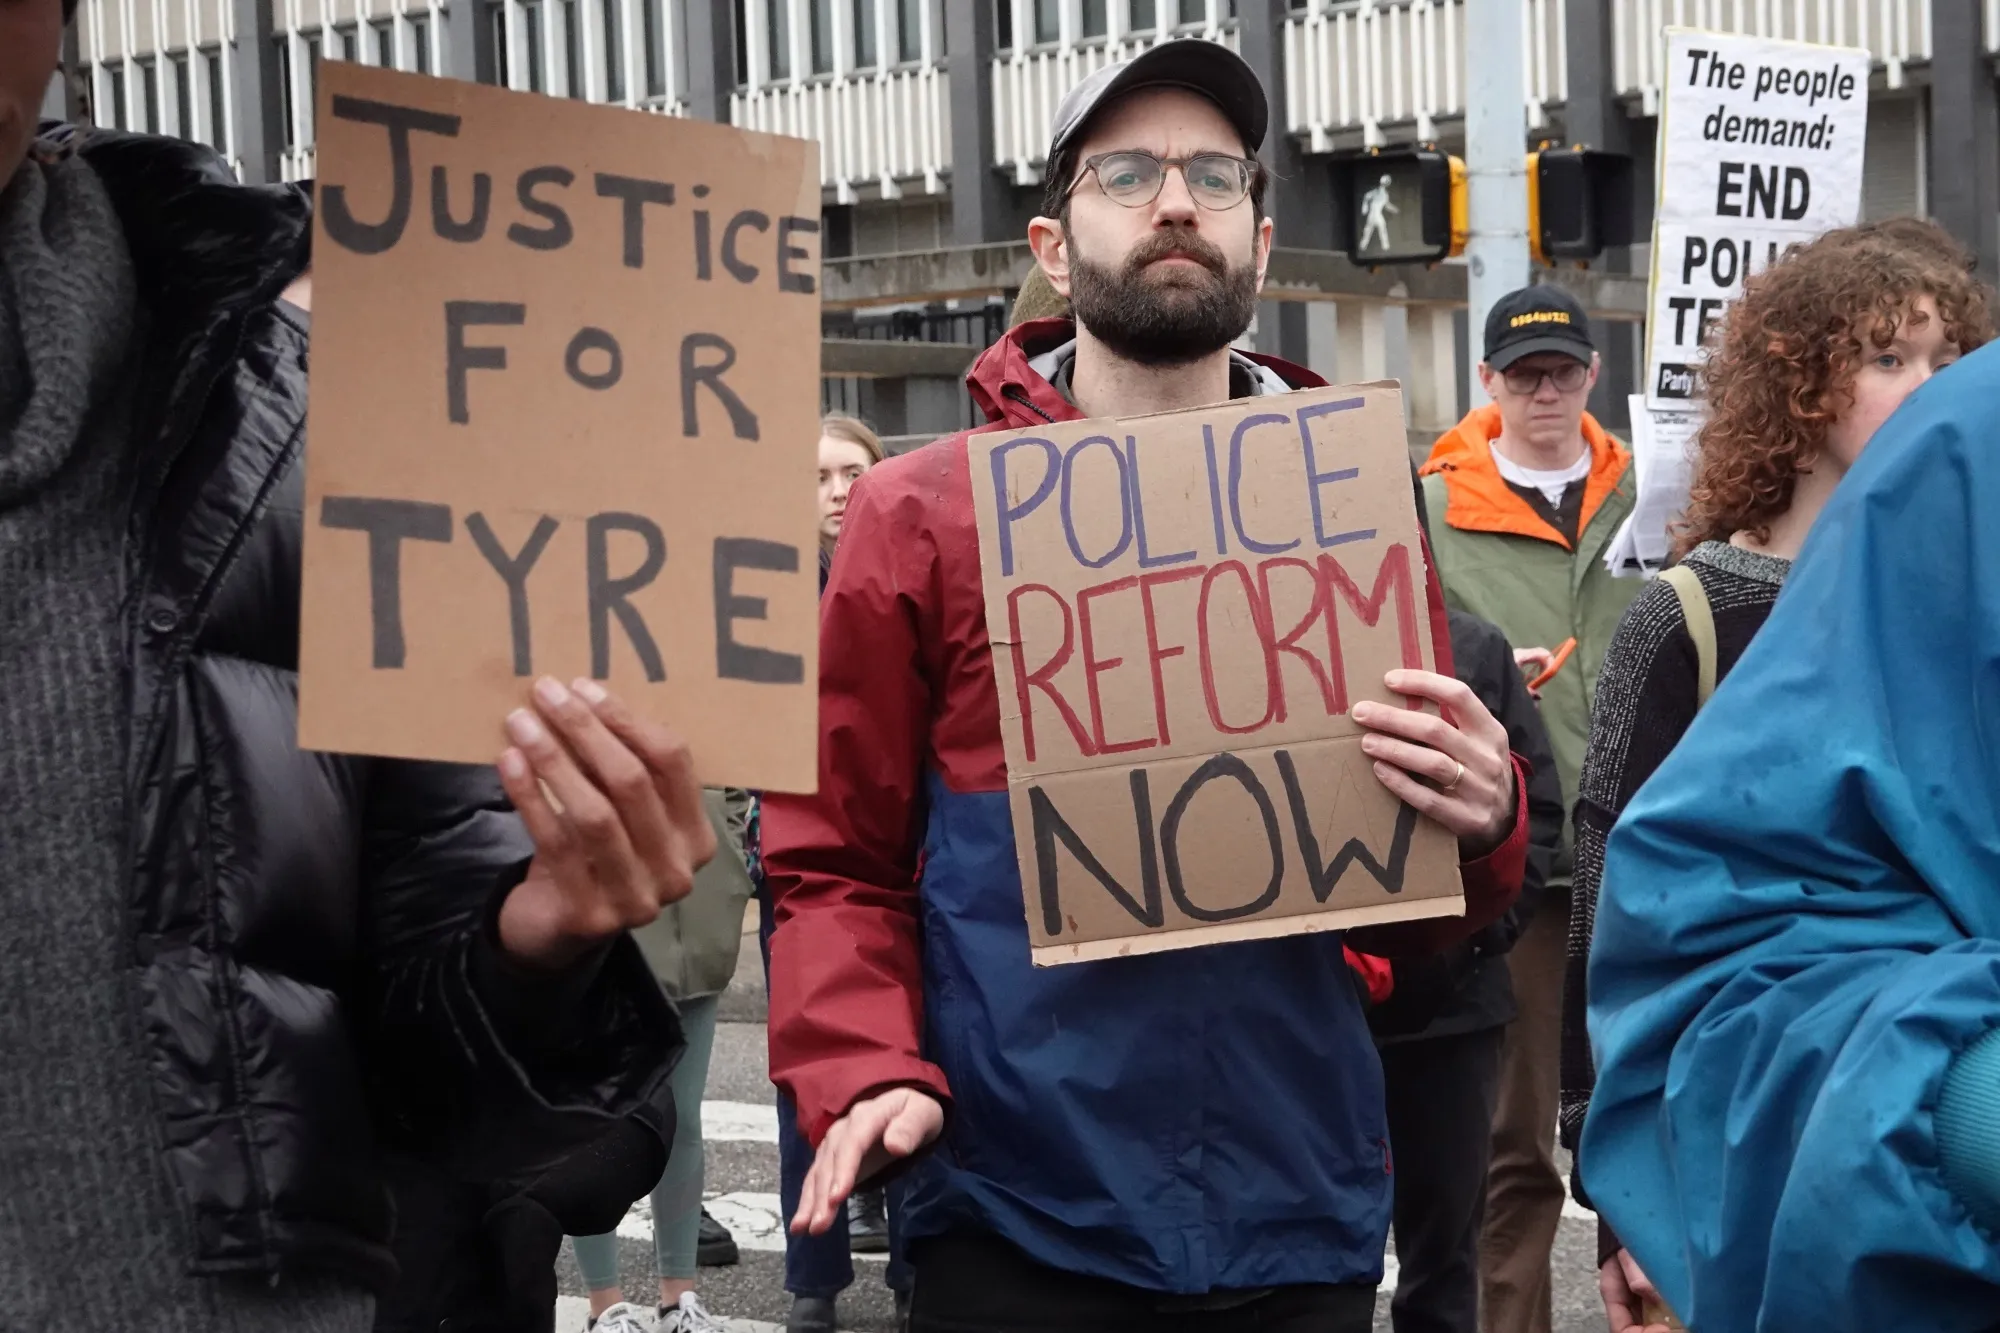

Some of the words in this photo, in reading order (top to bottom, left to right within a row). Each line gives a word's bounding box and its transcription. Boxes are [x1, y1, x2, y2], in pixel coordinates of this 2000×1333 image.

[1687, 49, 1745, 89] The
[1754, 64, 1855, 107] people
[1703, 105, 1835, 150] demand:
[1716, 162, 1811, 221] END
[444, 300, 760, 441] FOR
[990, 397, 1377, 577] POLICE
[320, 496, 805, 684] TYRE
[1007, 543, 1424, 762] REFORM
[1028, 750, 1419, 936] NOW
